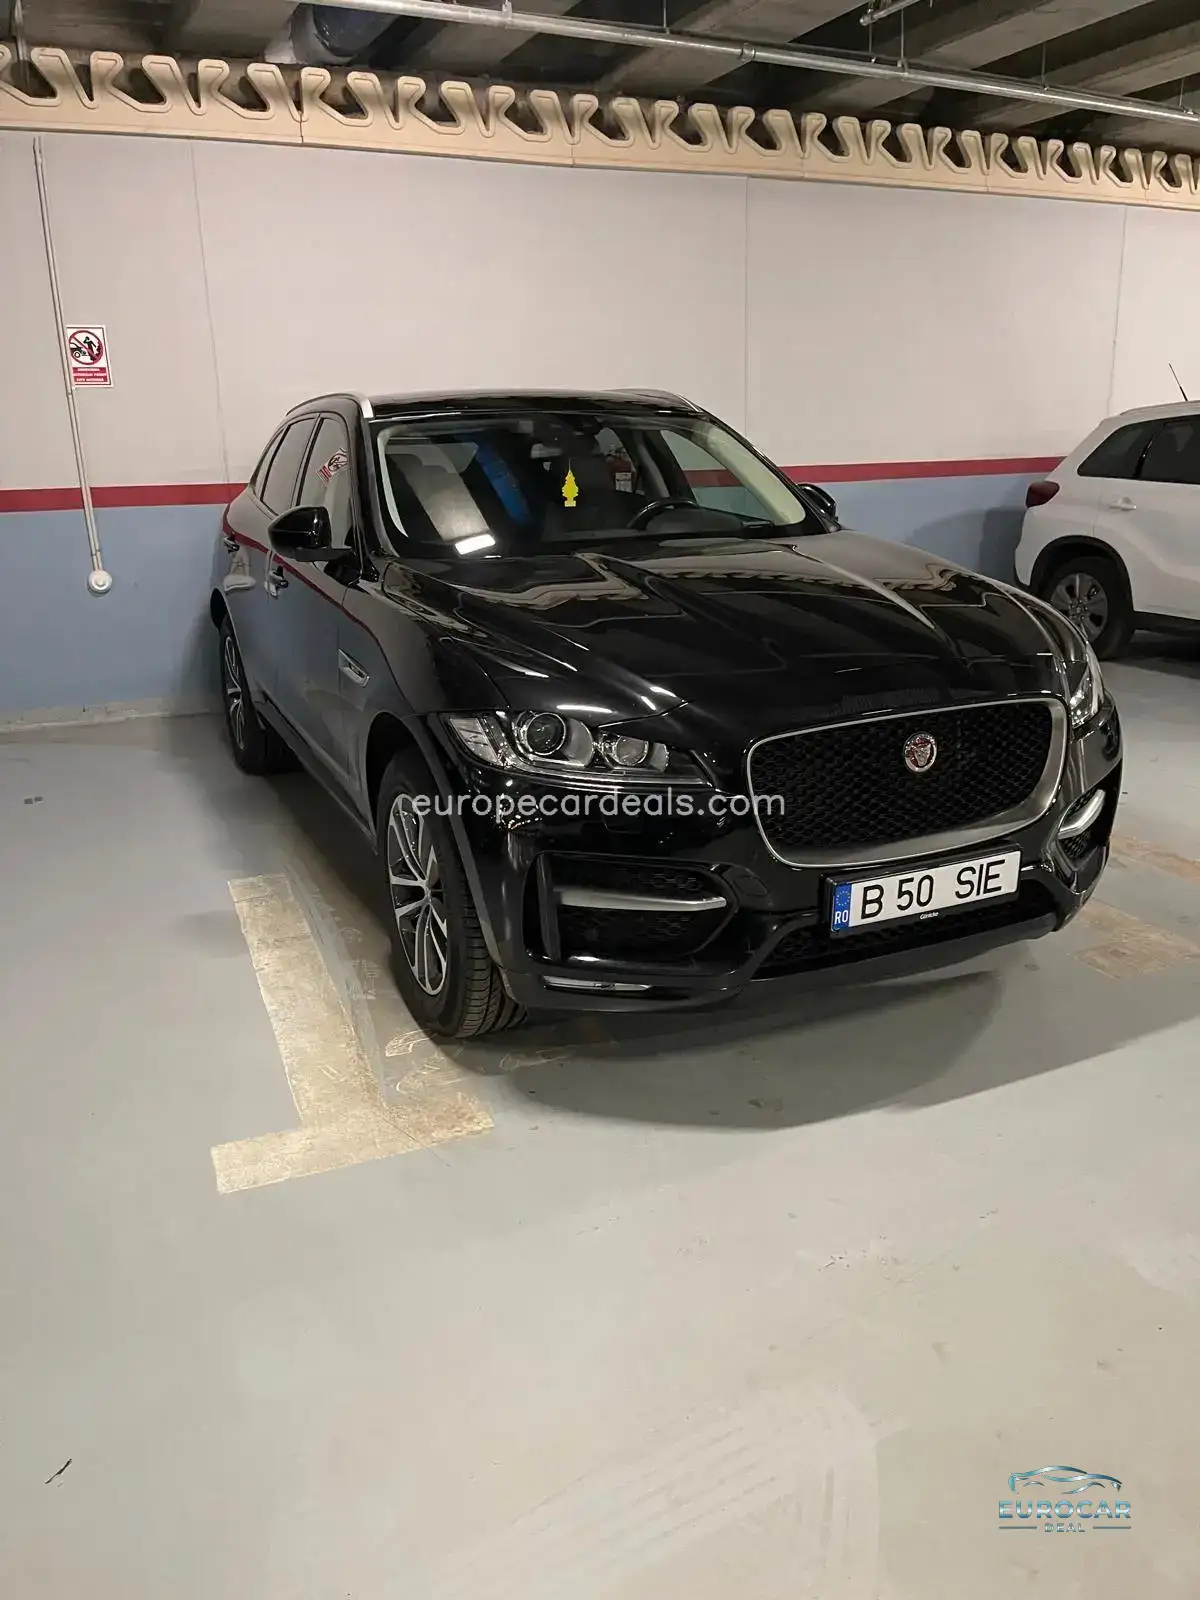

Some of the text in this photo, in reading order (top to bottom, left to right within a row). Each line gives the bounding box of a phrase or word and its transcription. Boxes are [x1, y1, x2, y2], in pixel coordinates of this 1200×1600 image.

[861, 859, 1005, 919] B 50 SIE
[834, 909, 849, 925] RO
